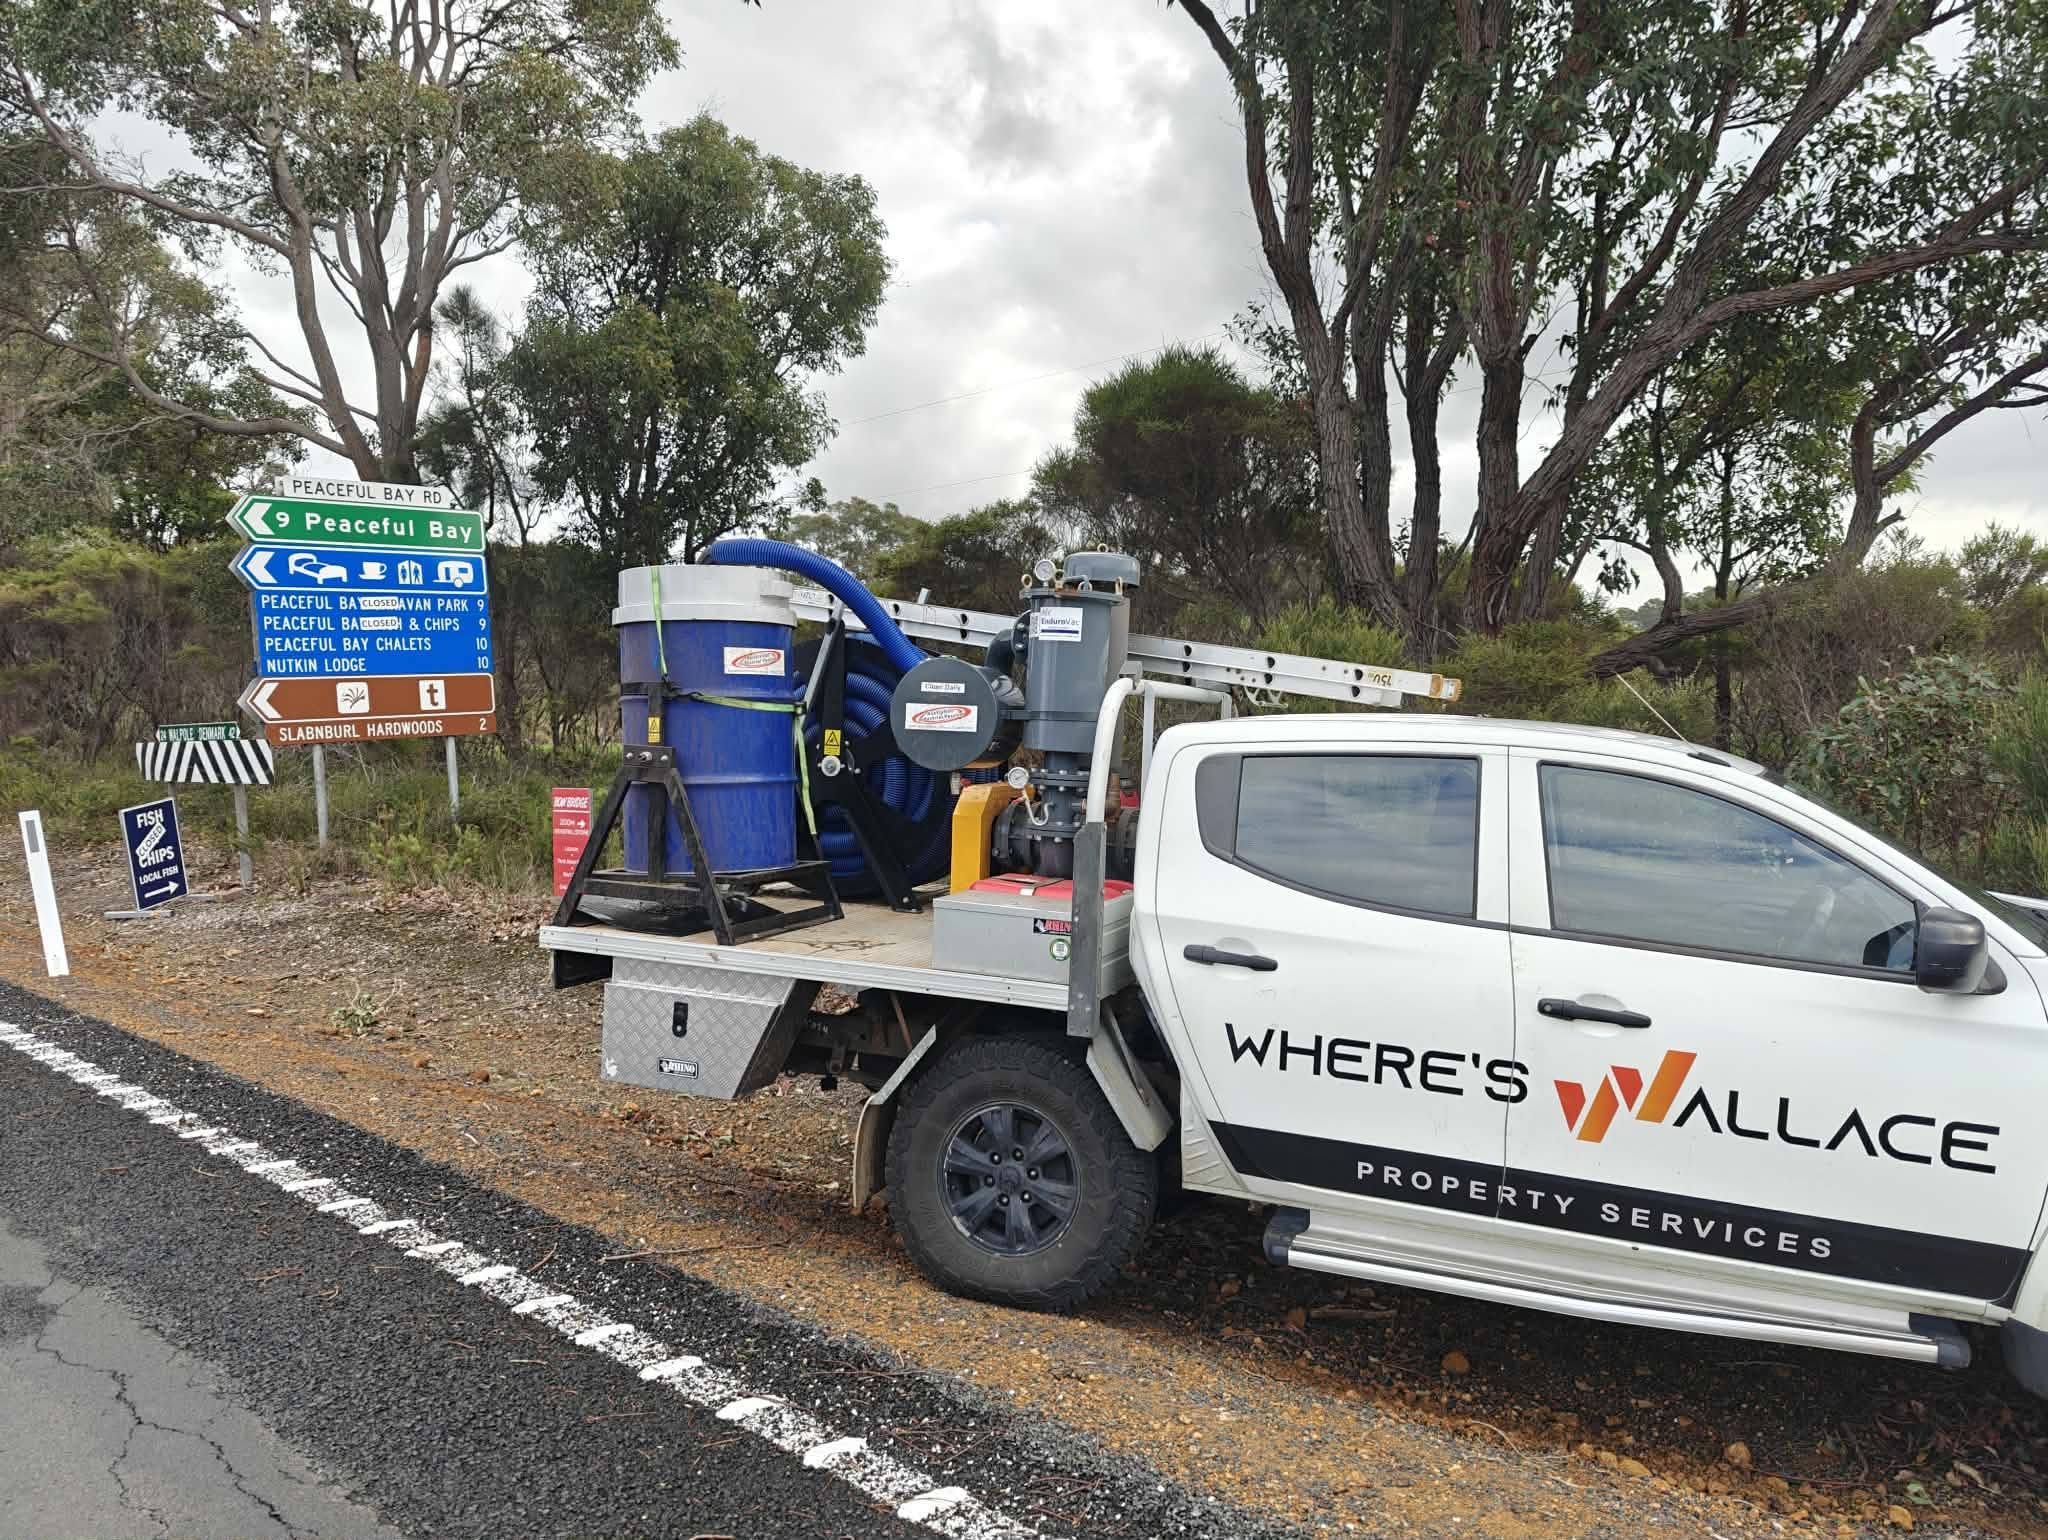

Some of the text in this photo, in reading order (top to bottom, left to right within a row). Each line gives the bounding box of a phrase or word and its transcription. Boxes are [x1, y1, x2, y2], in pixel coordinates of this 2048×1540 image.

[292, 480, 442, 504] PEACEFUL BAY RD
[275, 511, 472, 544] 9 Peaceful Bay
[261, 595, 333, 610] PEACEFUL
[340, 596, 362, 610] BA
[437, 598, 469, 612] PARK
[476, 599, 485, 611] 9
[361, 599, 398, 608] CLOSED
[263, 615, 336, 631] PEACEFUL
[341, 616, 361, 631] BA
[409, 617, 420, 631] &
[424, 617, 460, 631] CHIPS
[478, 618, 486, 631] 9
[361, 618, 398, 628] CLOSED
[265, 637, 488, 652] PEACEFUL BAY CHALETS 10
[267, 656, 489, 673] NUTKIN LODGE 10
[168, 727, 194, 741] WALPOLE
[198, 726, 226, 741] DENMARK
[279, 718, 487, 742] SLABNBURL HARDWOODS 2
[136, 808, 164, 829] FISH
[139, 826, 163, 857] CLOSED
[139, 846, 175, 868] CHIPS
[139, 865, 179, 885] LOCAL FISH
[1044, 920, 1072, 932] RHIN
[669, 1062, 696, 1073] RHINO
[1225, 1022, 1529, 1105] WHERE'S
[1554, 1049, 2001, 1175] WALLACE
[1356, 1160, 1834, 1260] PROPERTY SERVICES
